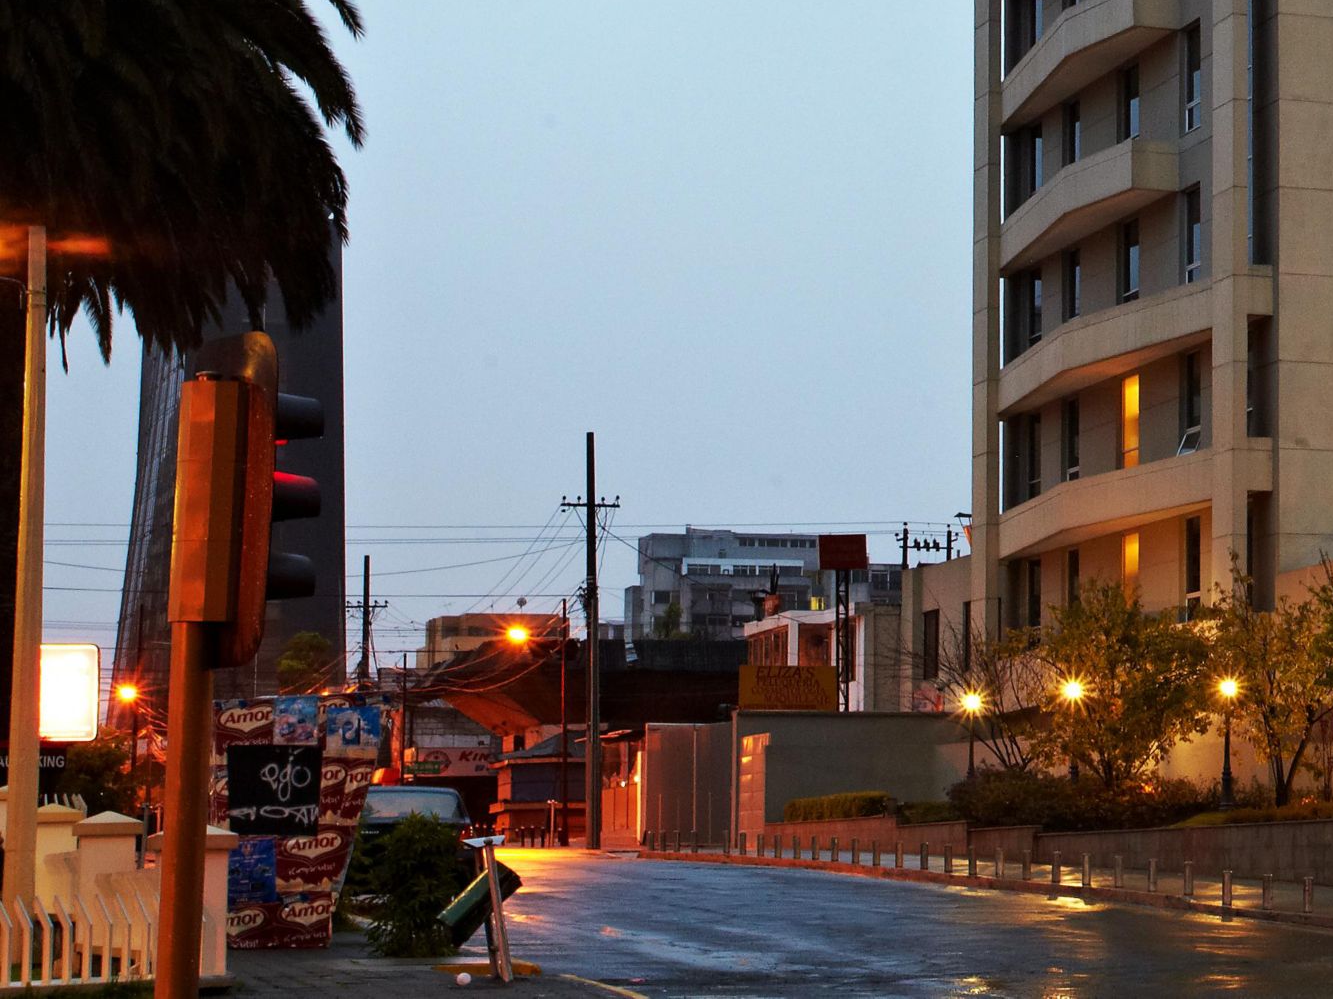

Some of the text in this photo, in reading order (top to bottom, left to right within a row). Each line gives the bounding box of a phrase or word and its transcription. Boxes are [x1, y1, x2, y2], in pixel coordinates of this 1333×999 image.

[756, 666, 815, 679] ELIZA'S
[225, 708, 272, 724] Amor
[290, 834, 338, 851] Amor
[285, 903, 332, 919] Amor
